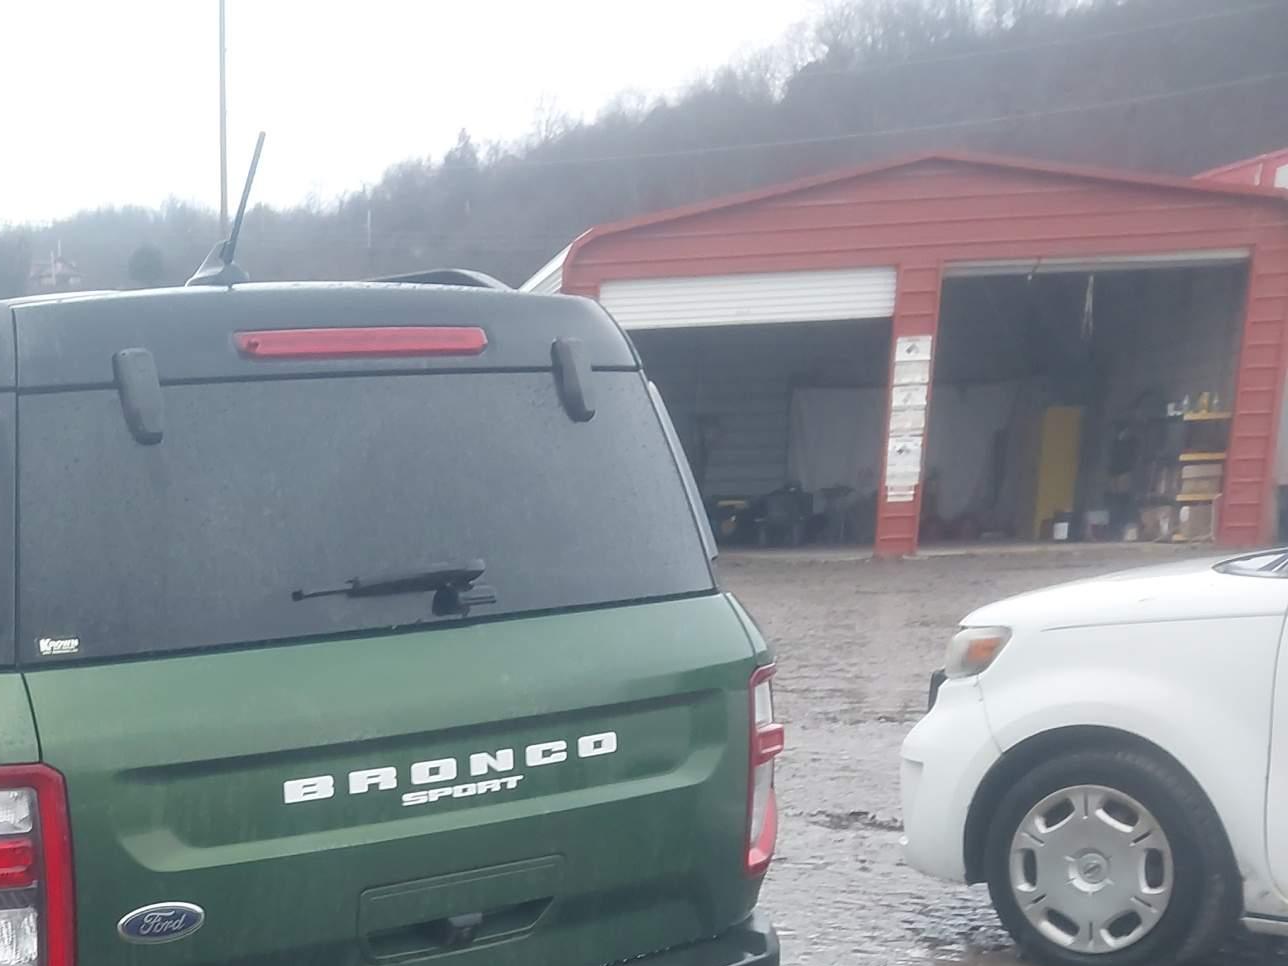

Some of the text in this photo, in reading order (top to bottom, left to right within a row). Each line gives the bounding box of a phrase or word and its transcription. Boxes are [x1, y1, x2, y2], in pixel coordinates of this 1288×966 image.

[283, 731, 618, 804] BRONCO
[402, 775, 524, 807] SPORT
[140, 910, 186, 935] Ford
